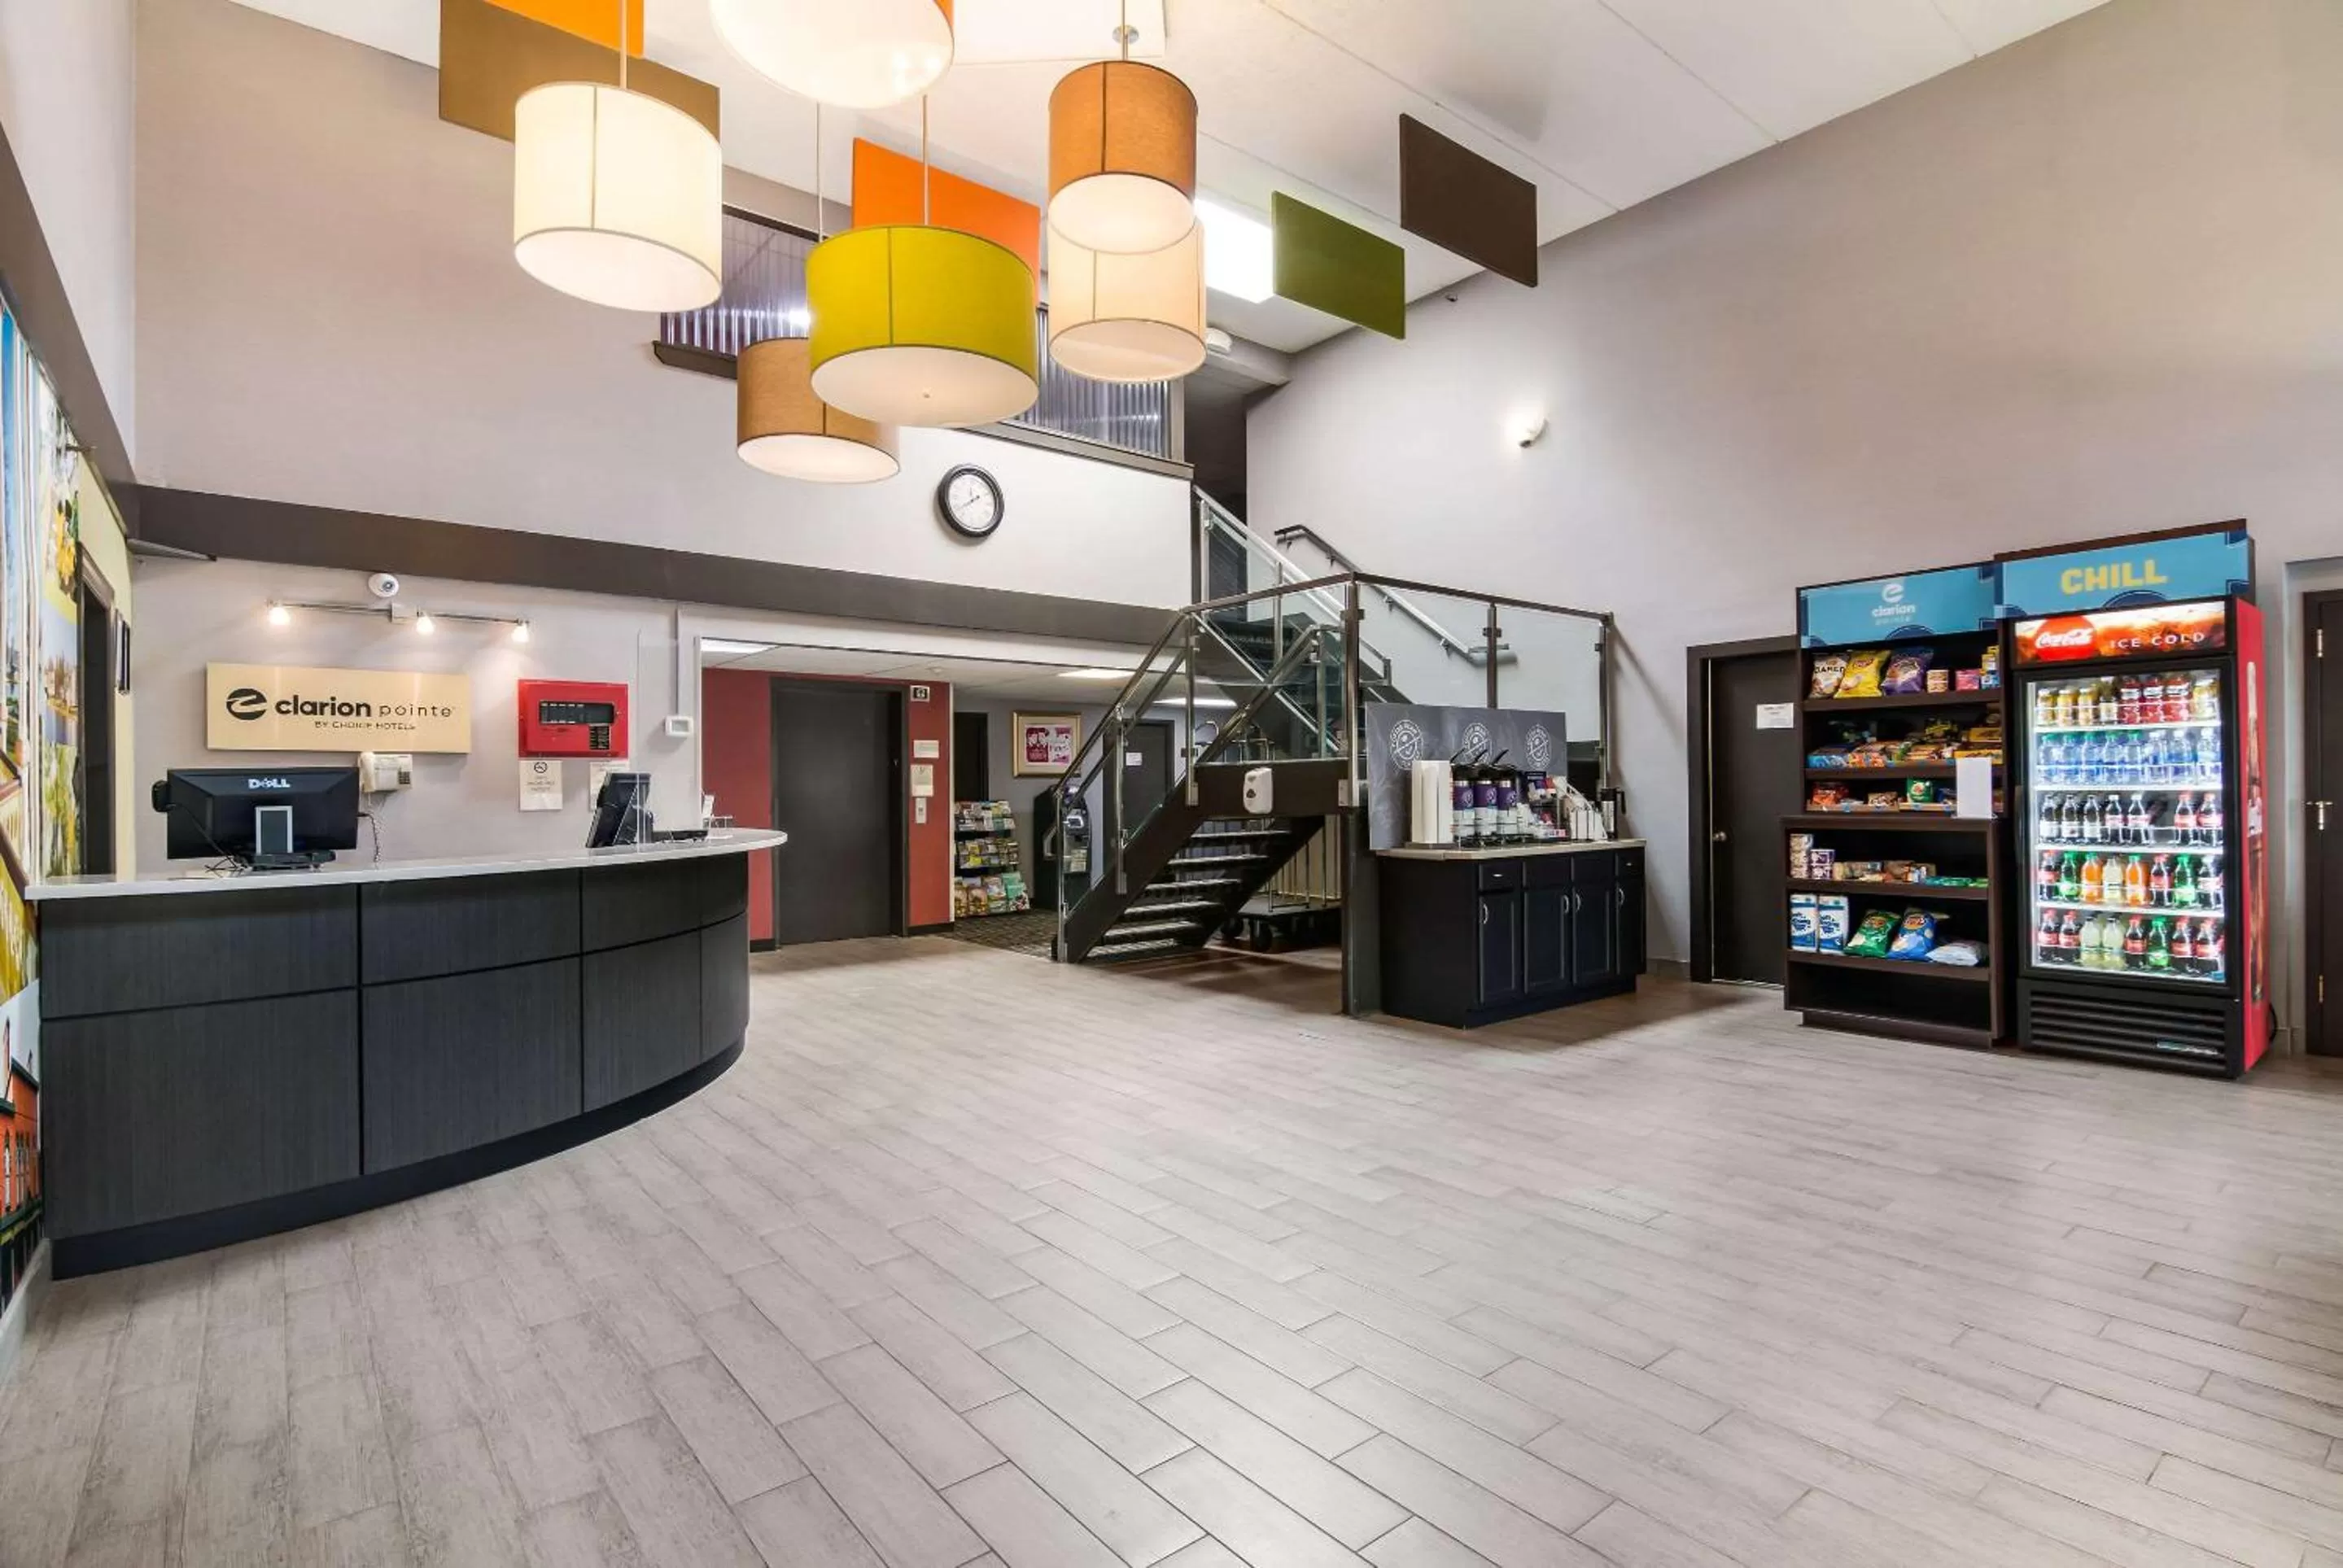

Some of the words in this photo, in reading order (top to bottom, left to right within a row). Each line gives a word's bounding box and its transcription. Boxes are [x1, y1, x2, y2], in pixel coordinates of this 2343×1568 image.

[2060, 559, 2168, 595] CHILL
[1872, 605, 1916, 617] clarion
[2035, 628, 2094, 649] Coca-Cola
[2109, 638, 2141, 649] ICE
[2152, 631, 2205, 646] COLD
[275, 694, 372, 718] clarion
[378, 703, 452, 718] pointe
[314, 721, 328, 729] BY
[247, 777, 291, 789] DELL
